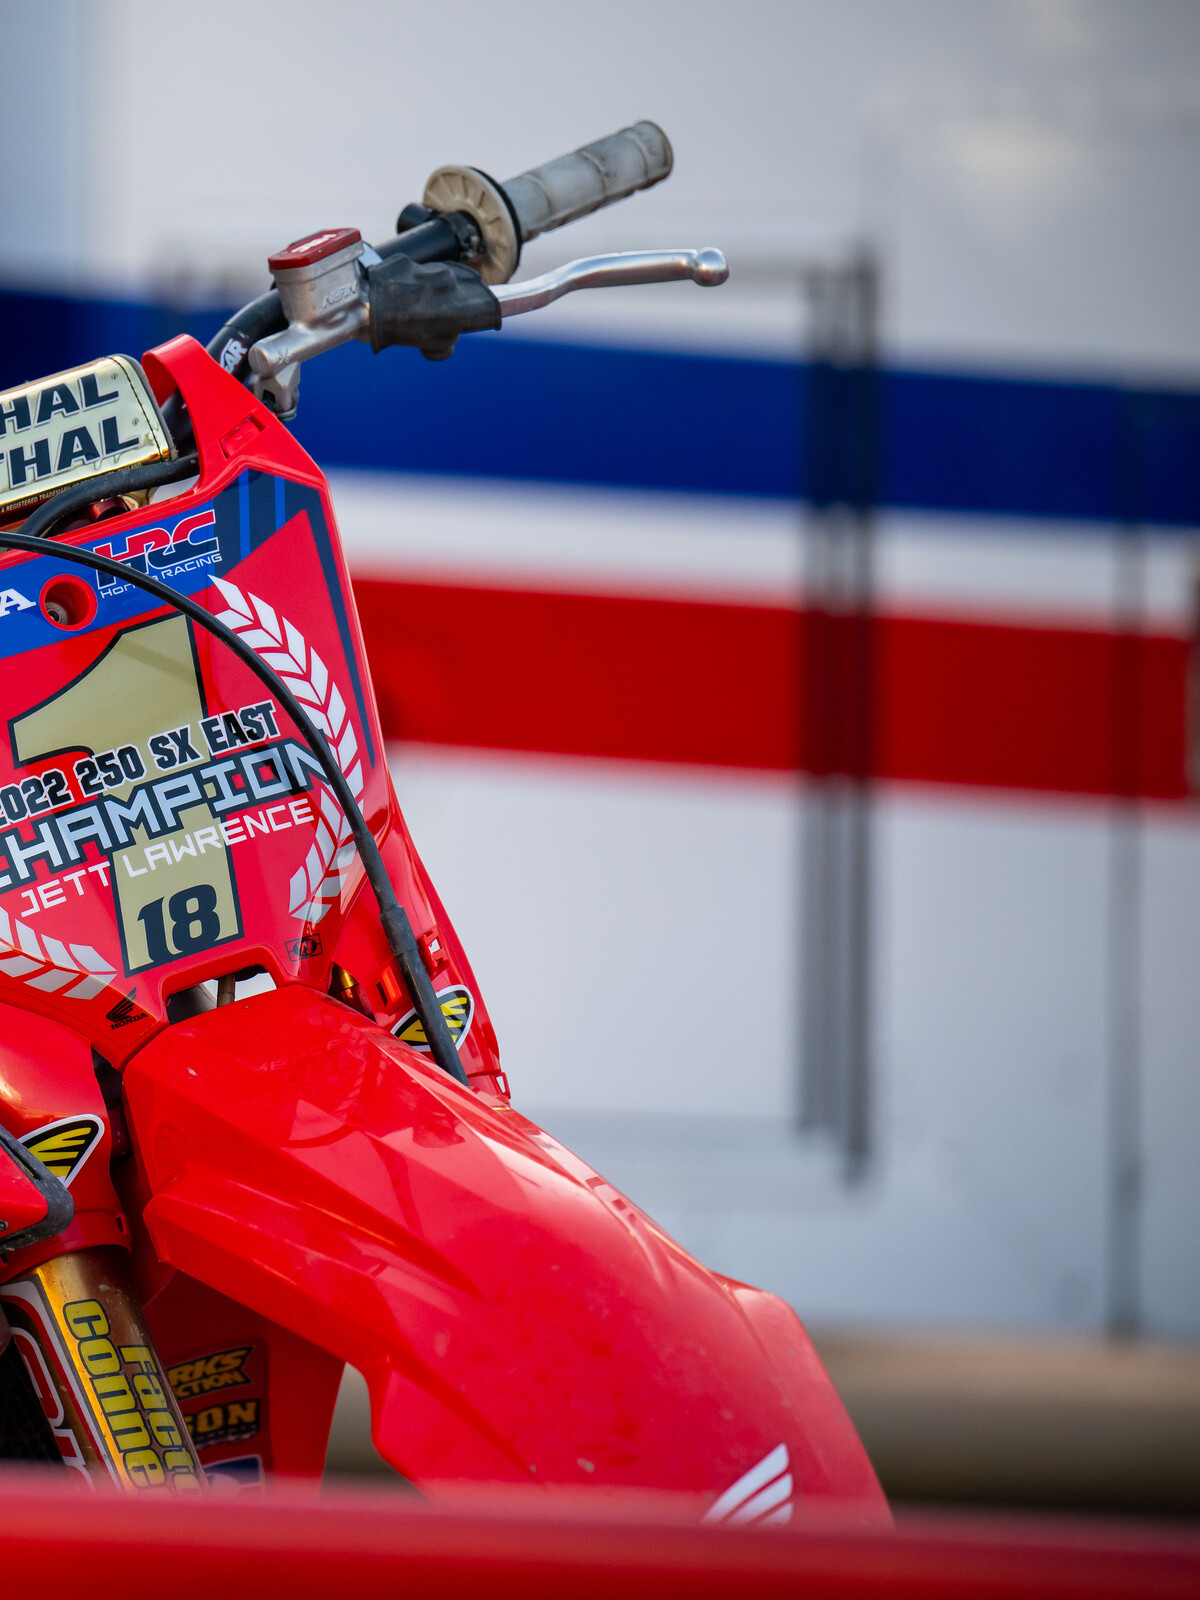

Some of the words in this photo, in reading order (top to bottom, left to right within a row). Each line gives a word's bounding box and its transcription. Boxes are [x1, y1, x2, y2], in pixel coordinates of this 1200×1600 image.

[6, 496, 39, 512] REGISTERED
[93, 509, 220, 590] HRC
[160, 553, 223, 579] RACING
[74, 744, 145, 796] 250
[148, 718, 203, 772] SX
[200, 699, 282, 757] EAST
[7, 611, 245, 978] 1
[20, 861, 111, 918] JETT
[122, 797, 315, 879] LAWRENCE
[137, 882, 221, 965] 18
[110, 1012, 149, 1031] HONDA
[63, 1299, 172, 1494] Conne
